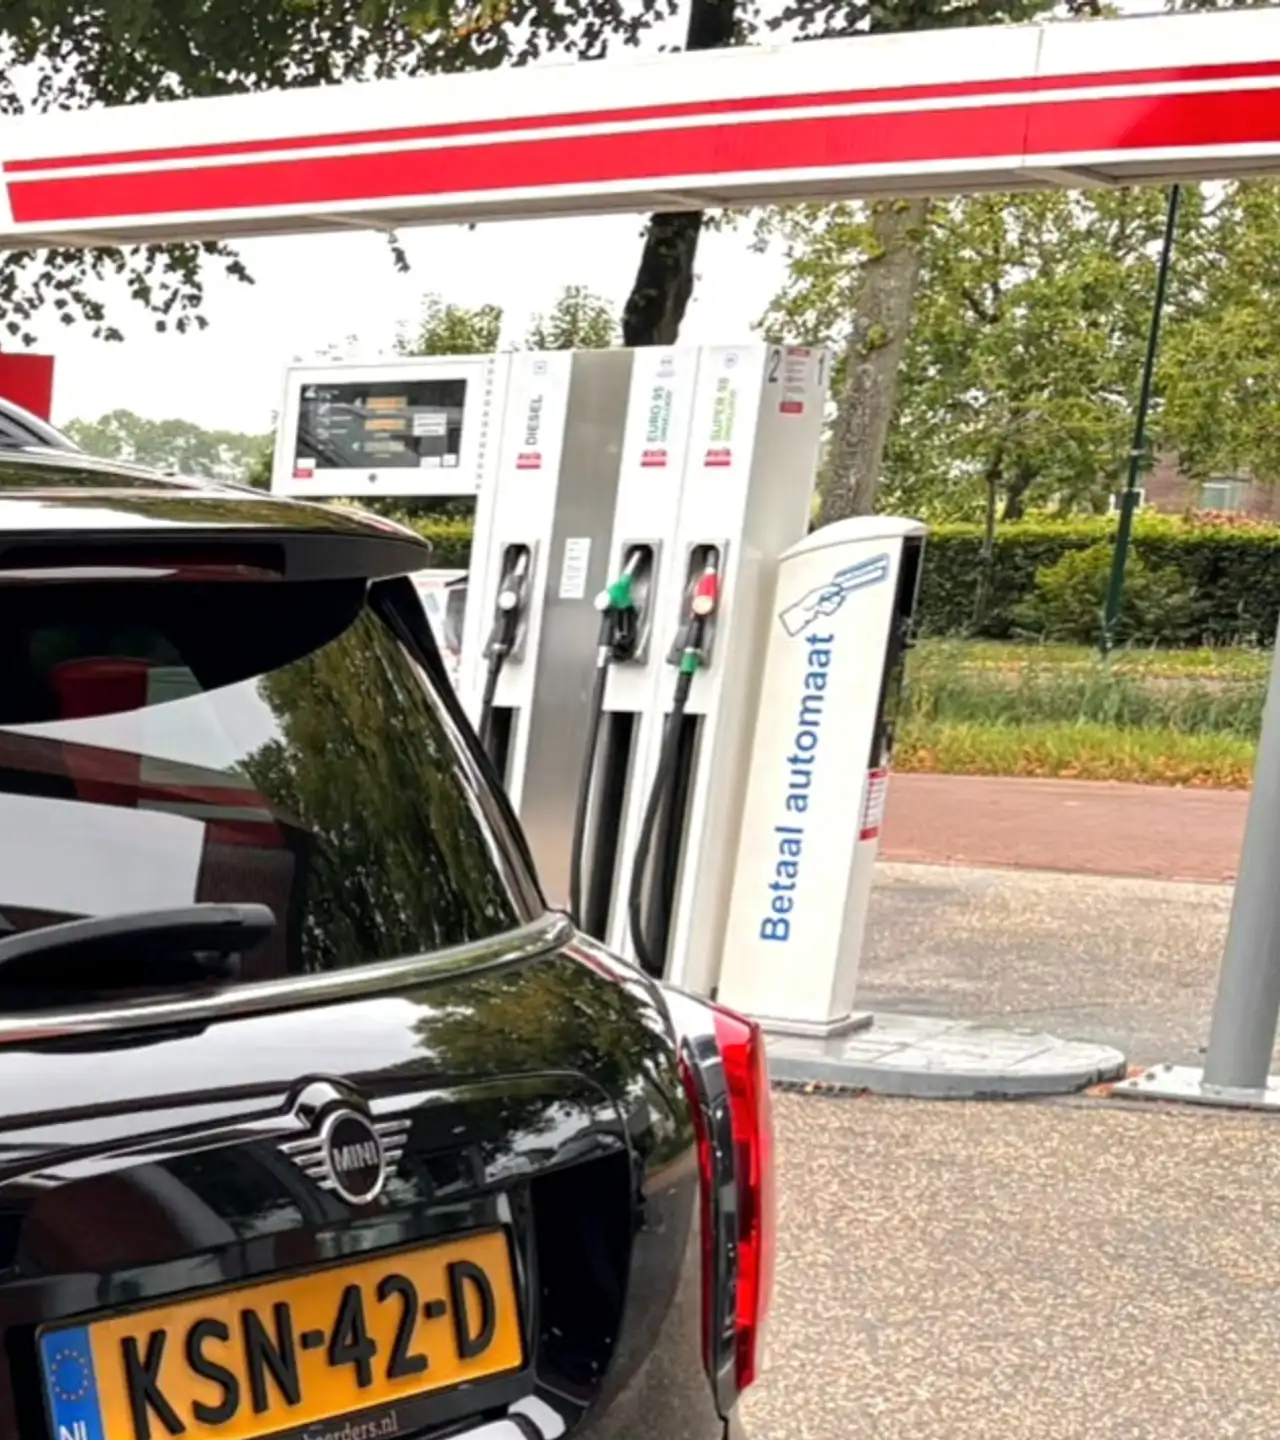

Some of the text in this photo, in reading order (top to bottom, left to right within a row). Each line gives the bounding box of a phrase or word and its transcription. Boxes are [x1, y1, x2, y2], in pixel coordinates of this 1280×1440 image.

[768, 348, 781, 384] 2
[525, 394, 543, 446] DIESEL
[646, 404, 662, 443] EURO
[709, 397, 726, 441] SUPER
[760, 632, 835, 942] Betaal automaat
[332, 1140, 379, 1172] MINI
